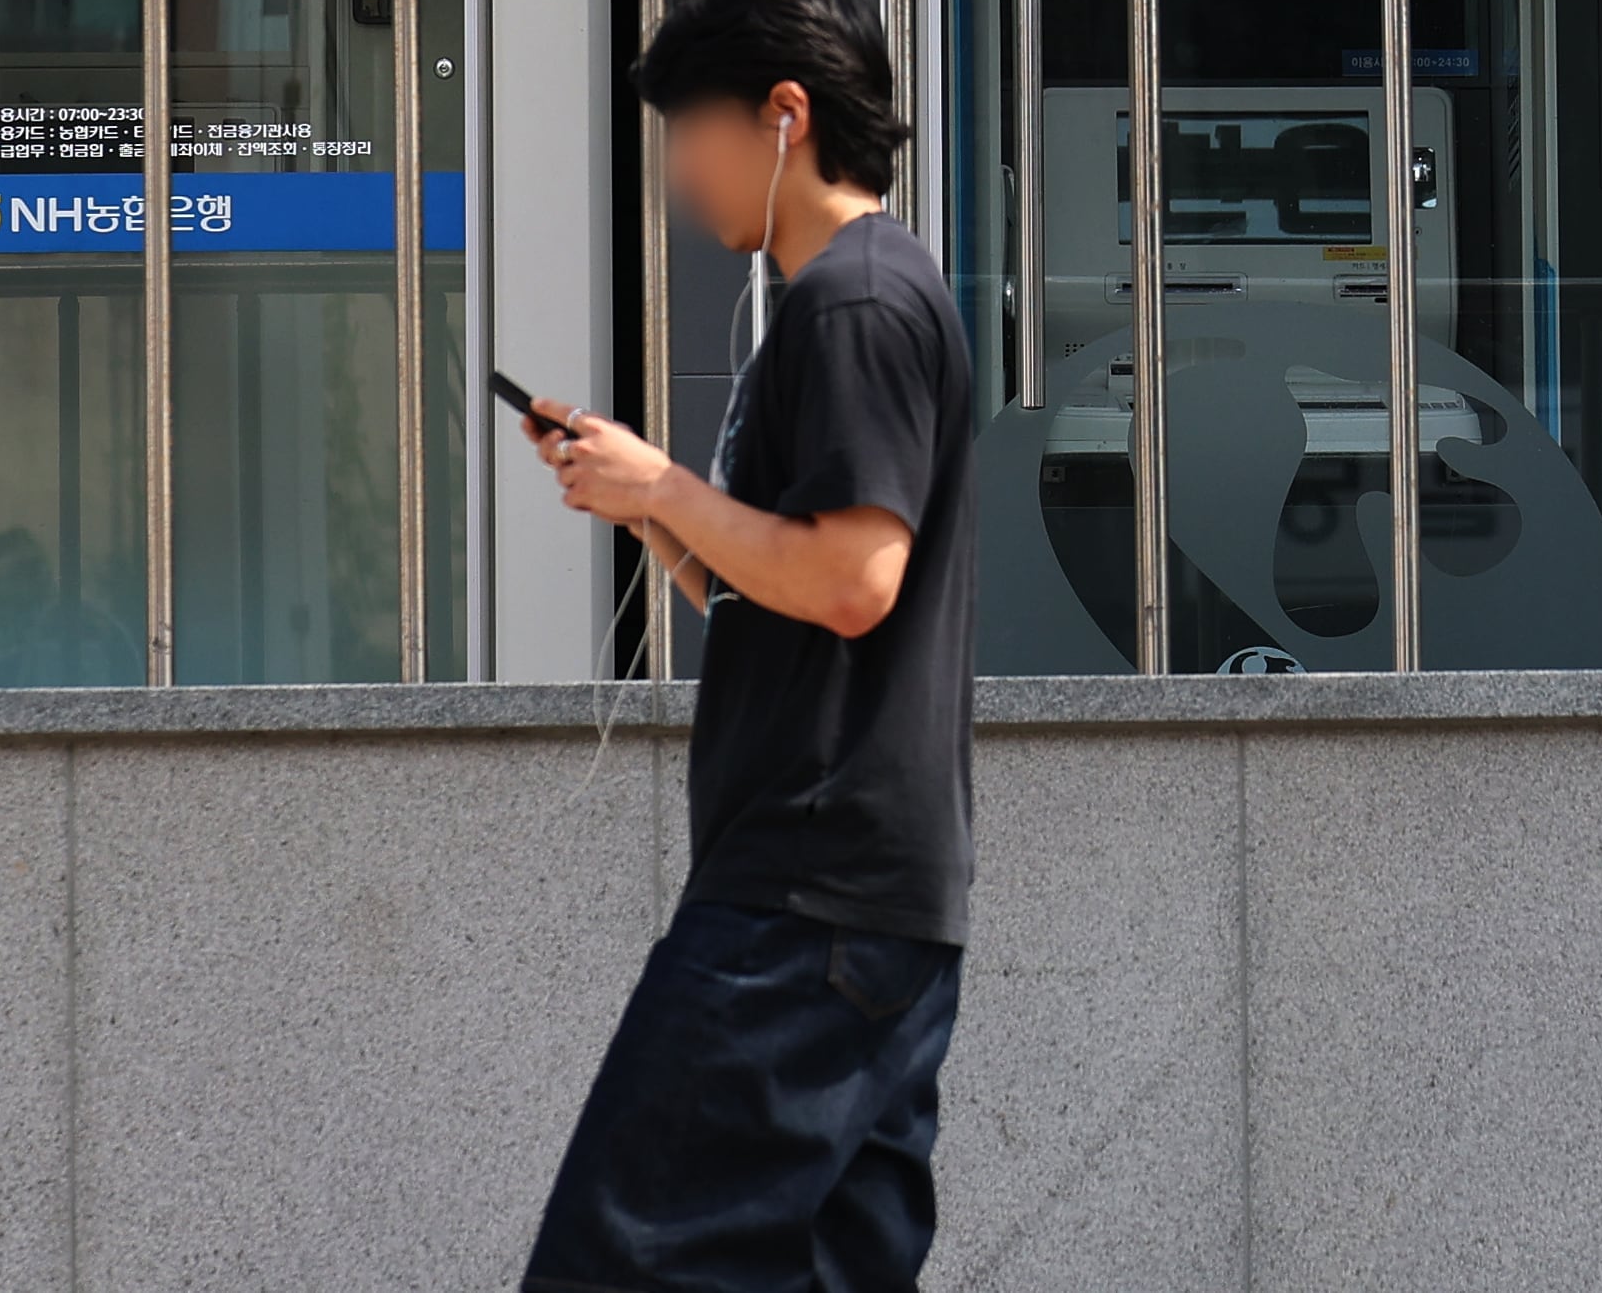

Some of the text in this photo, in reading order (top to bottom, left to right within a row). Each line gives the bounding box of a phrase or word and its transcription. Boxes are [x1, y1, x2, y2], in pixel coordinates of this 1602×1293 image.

[1352, 57, 1385, 68] 이용시
[59, 125, 118, 139] 농협카드
[208, 123, 312, 139] 전금융기관사용
[237, 141, 297, 157] 잔액조회
[312, 141, 372, 156] 통장정리
